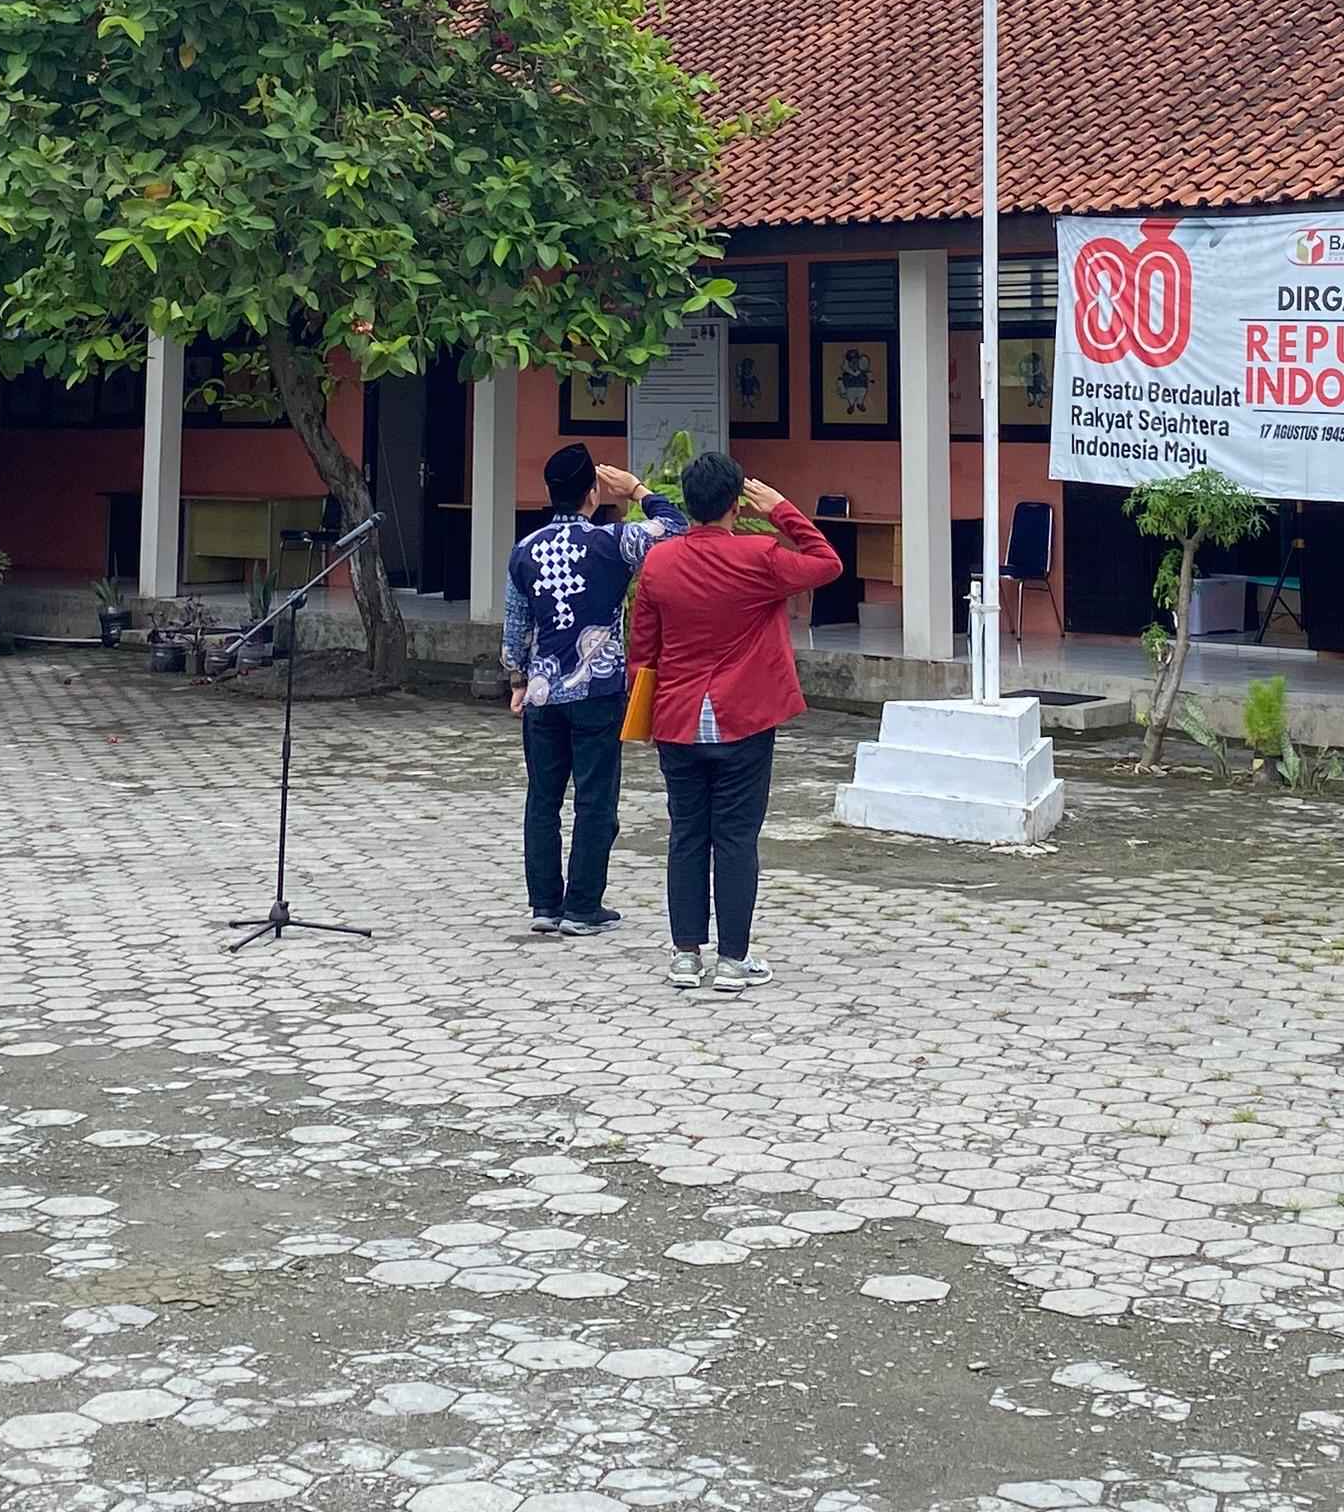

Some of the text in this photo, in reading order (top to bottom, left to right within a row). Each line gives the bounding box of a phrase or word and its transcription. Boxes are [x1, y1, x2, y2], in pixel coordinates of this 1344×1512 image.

[1074, 237, 1192, 368] 80
[1071, 376, 1241, 408] Bersatu Berdaulat
[1071, 404, 1230, 438] Rakyat Sejahtera
[1259, 423, 1273, 439] 17
[1273, 424, 1319, 442] AGUSTUS
[1071, 433, 1208, 470] Indonesia Maju
